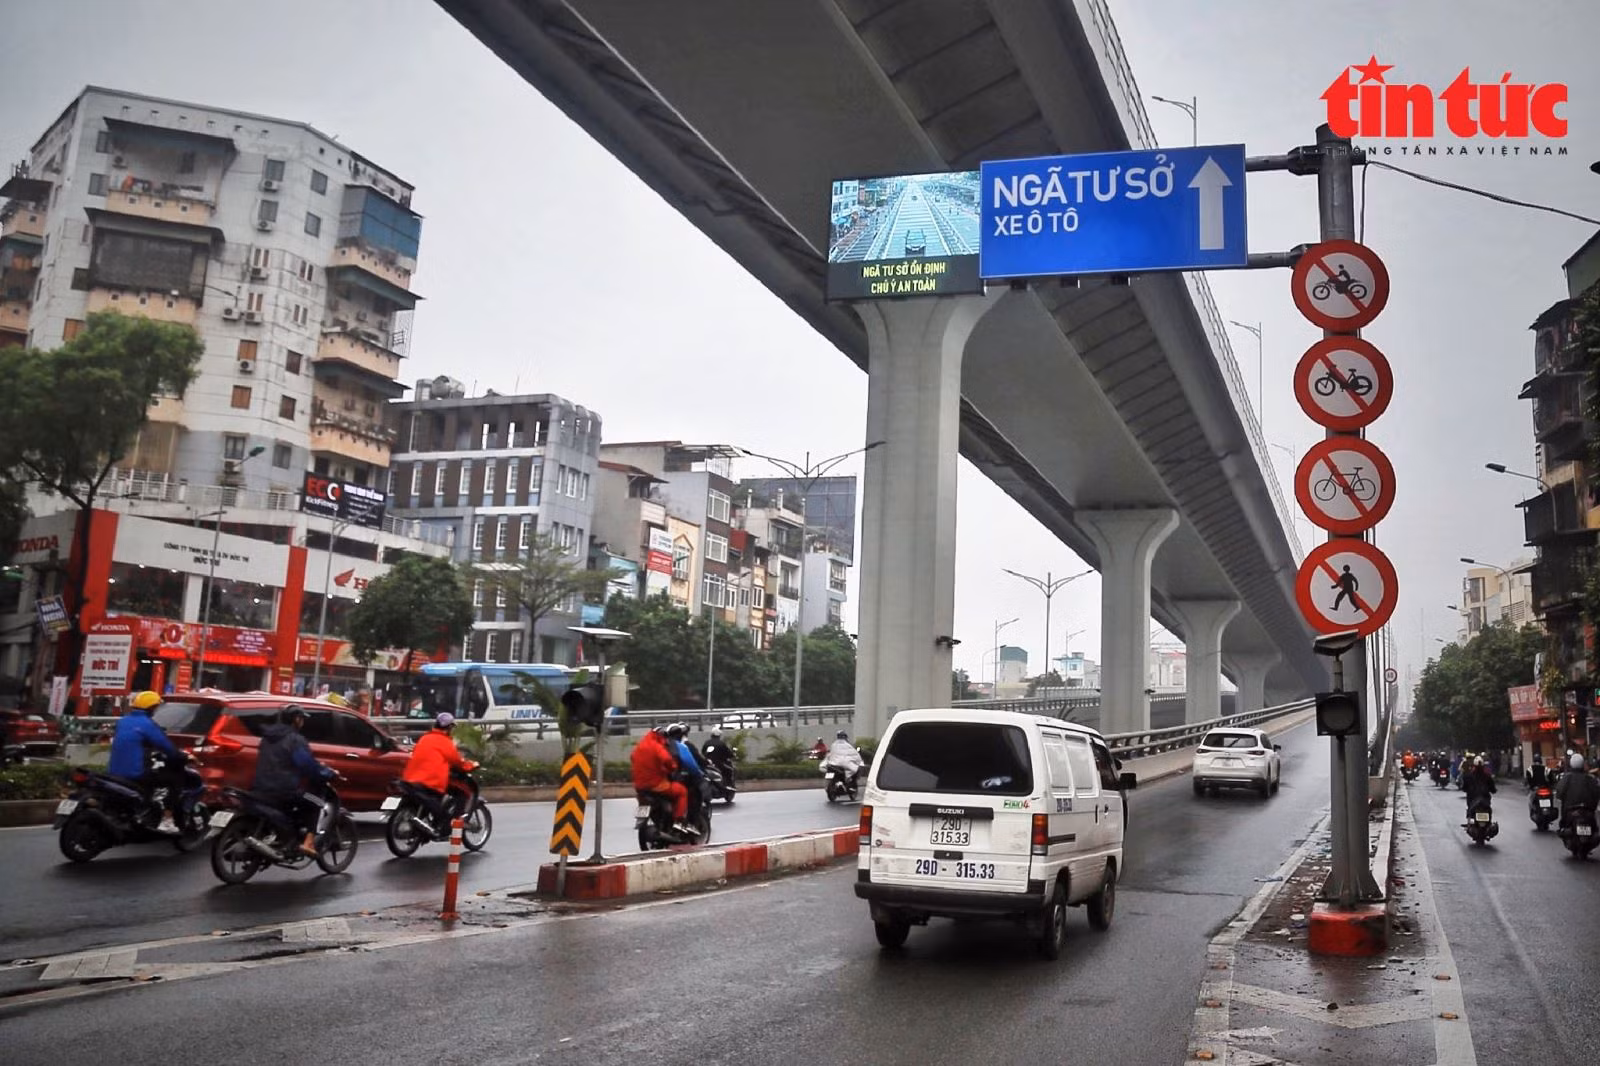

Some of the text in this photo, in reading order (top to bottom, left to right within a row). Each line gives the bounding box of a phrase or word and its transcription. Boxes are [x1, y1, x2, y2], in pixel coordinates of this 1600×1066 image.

[994, 153, 1175, 208] NGÃ TƯ SỞ
[994, 207, 1079, 236] XE Ô TÔ
[898, 281, 910, 293] AN
[941, 817, 962, 831] 29D
[932, 831, 969, 844] 315.33
[916, 859, 938, 876] 29D
[956, 862, 995, 879] 315.33
